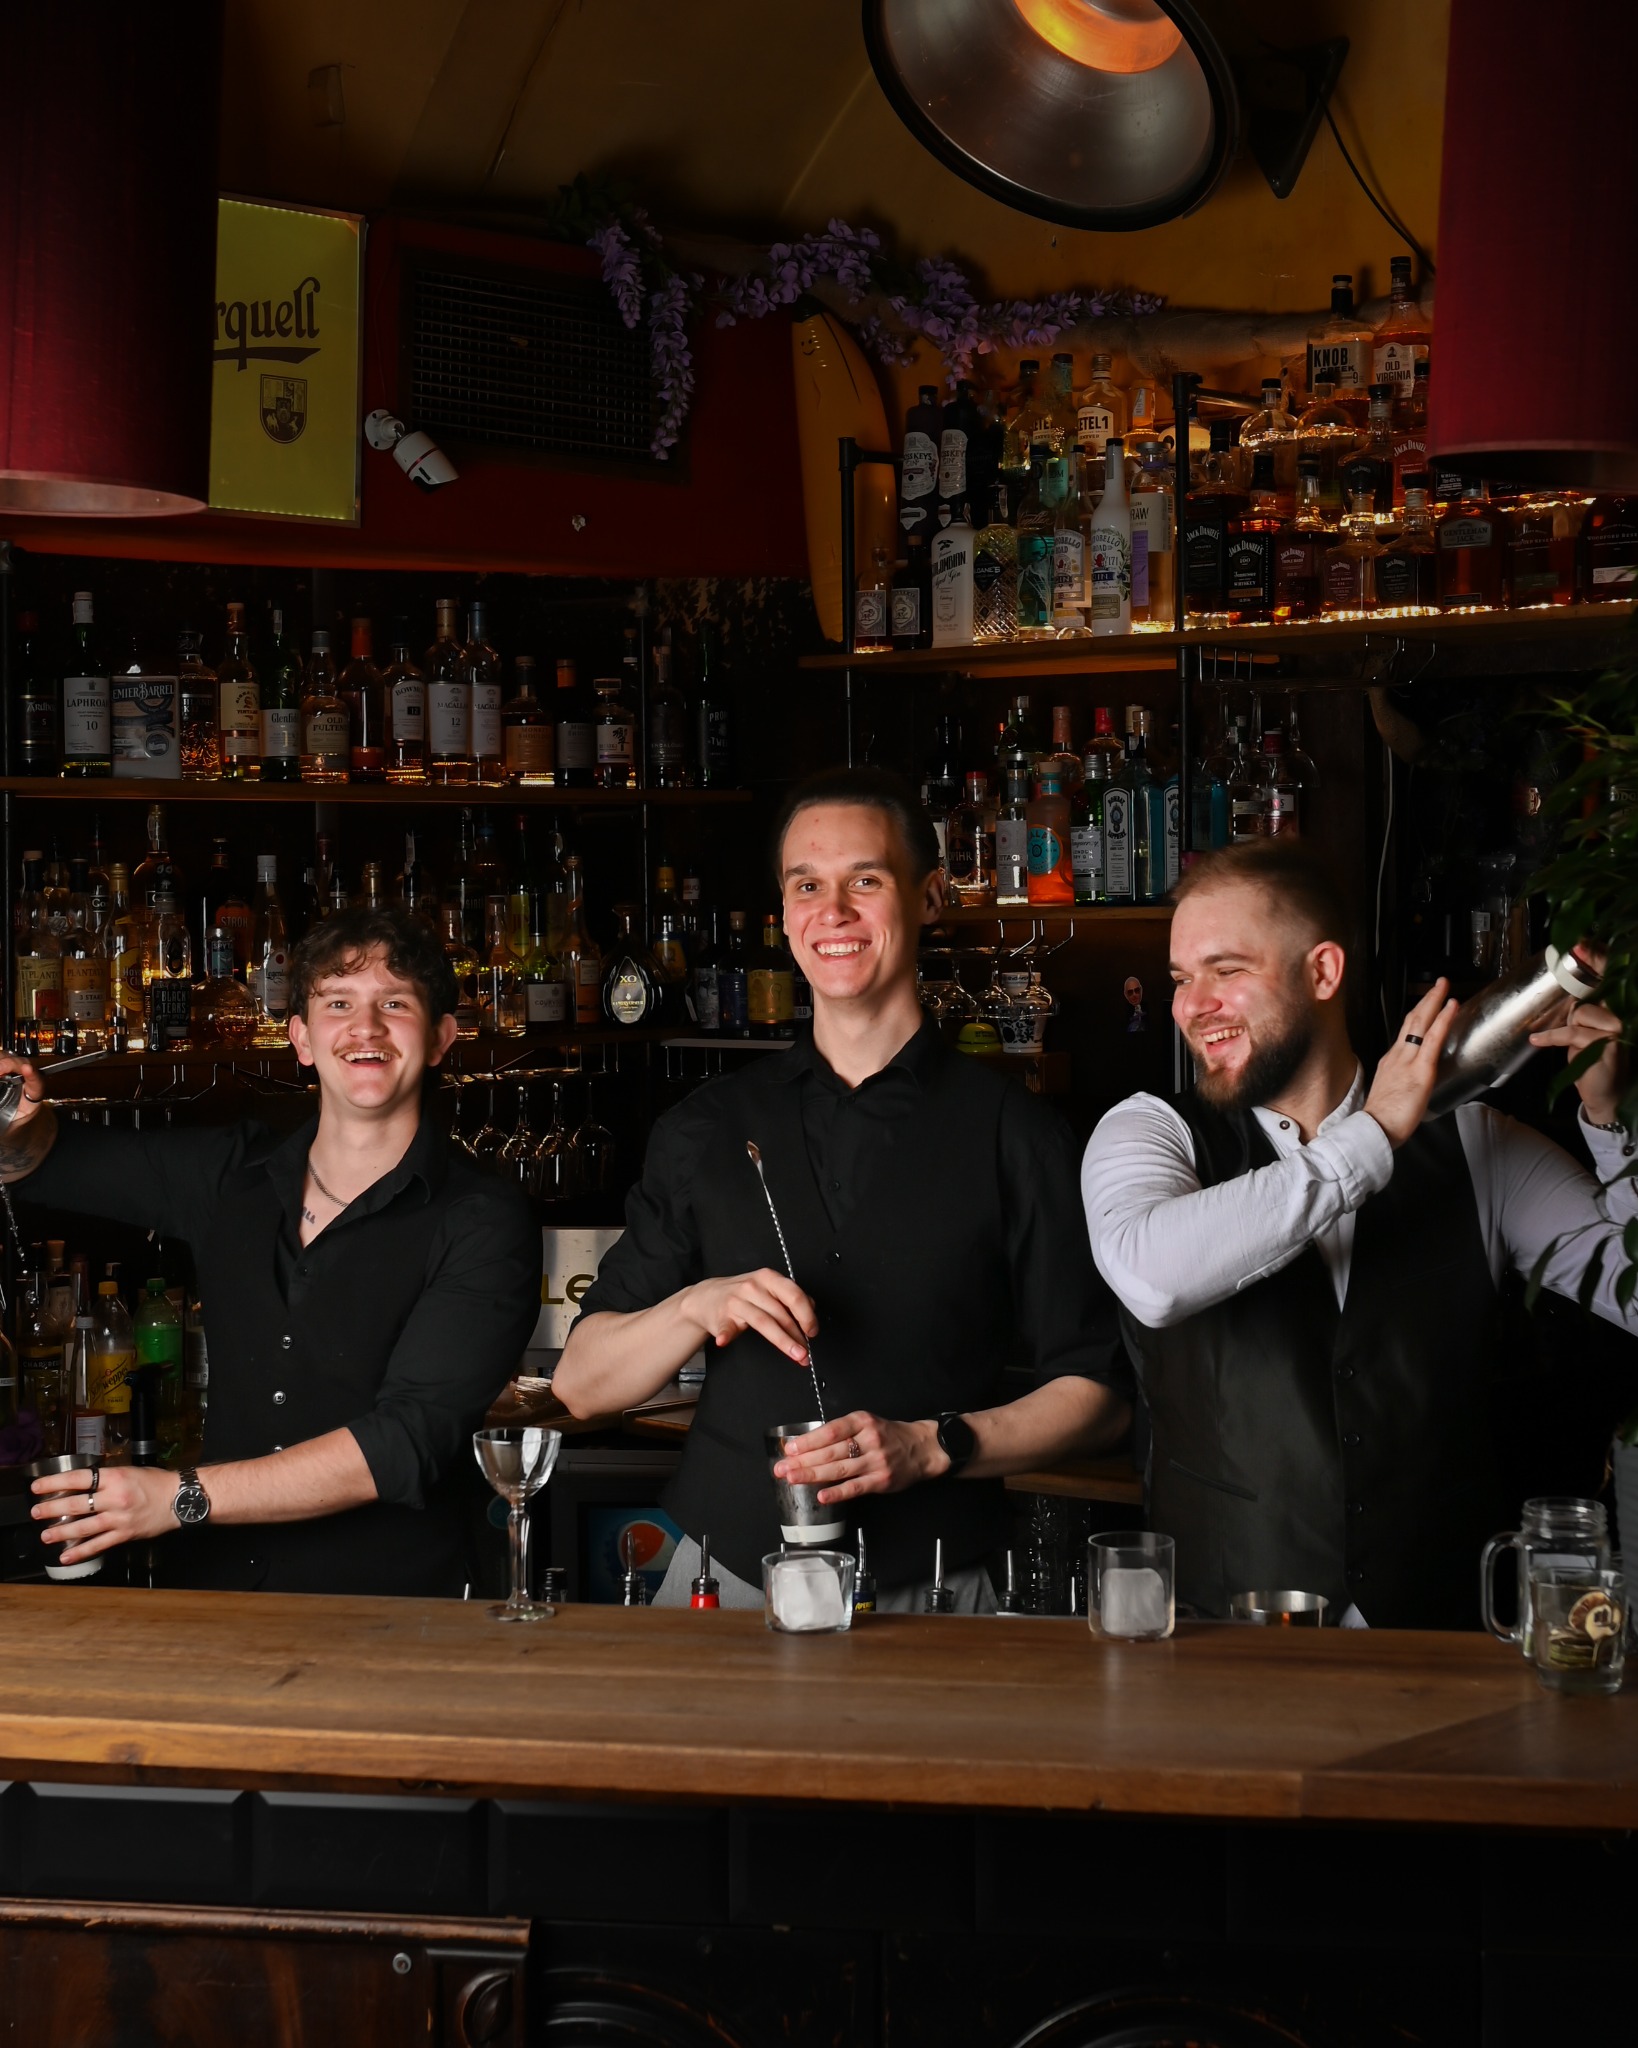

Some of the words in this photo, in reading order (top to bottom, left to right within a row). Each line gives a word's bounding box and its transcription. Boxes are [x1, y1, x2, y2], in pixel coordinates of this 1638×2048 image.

[1313, 347, 1348, 367] KNOB
[1320, 365, 1355, 374] CREEK
[1384, 361, 1399, 371] OLD
[1353, 371, 1359, 384] 9
[1376, 370, 1411, 382] VIRGINIA
[913, 452, 932, 460] KEYS
[1392, 445, 1406, 457] JACK
[1186, 531, 1199, 543] JACK
[1443, 527, 1488, 537] GENTLEMAN
[1457, 535, 1474, 543] JACK
[1229, 545, 1242, 558] JACK
[1242, 540, 1265, 556] DANIEL'S
[138, 682, 174, 700] BARREL
[86, 721, 98, 731] 10
[451, 718, 460, 726] 12
[221, 916, 248, 928] STROH
[620, 975, 637, 983] XO
[161, 990, 186, 1002] BLACK
[162, 1002, 186, 1014] TEARS
